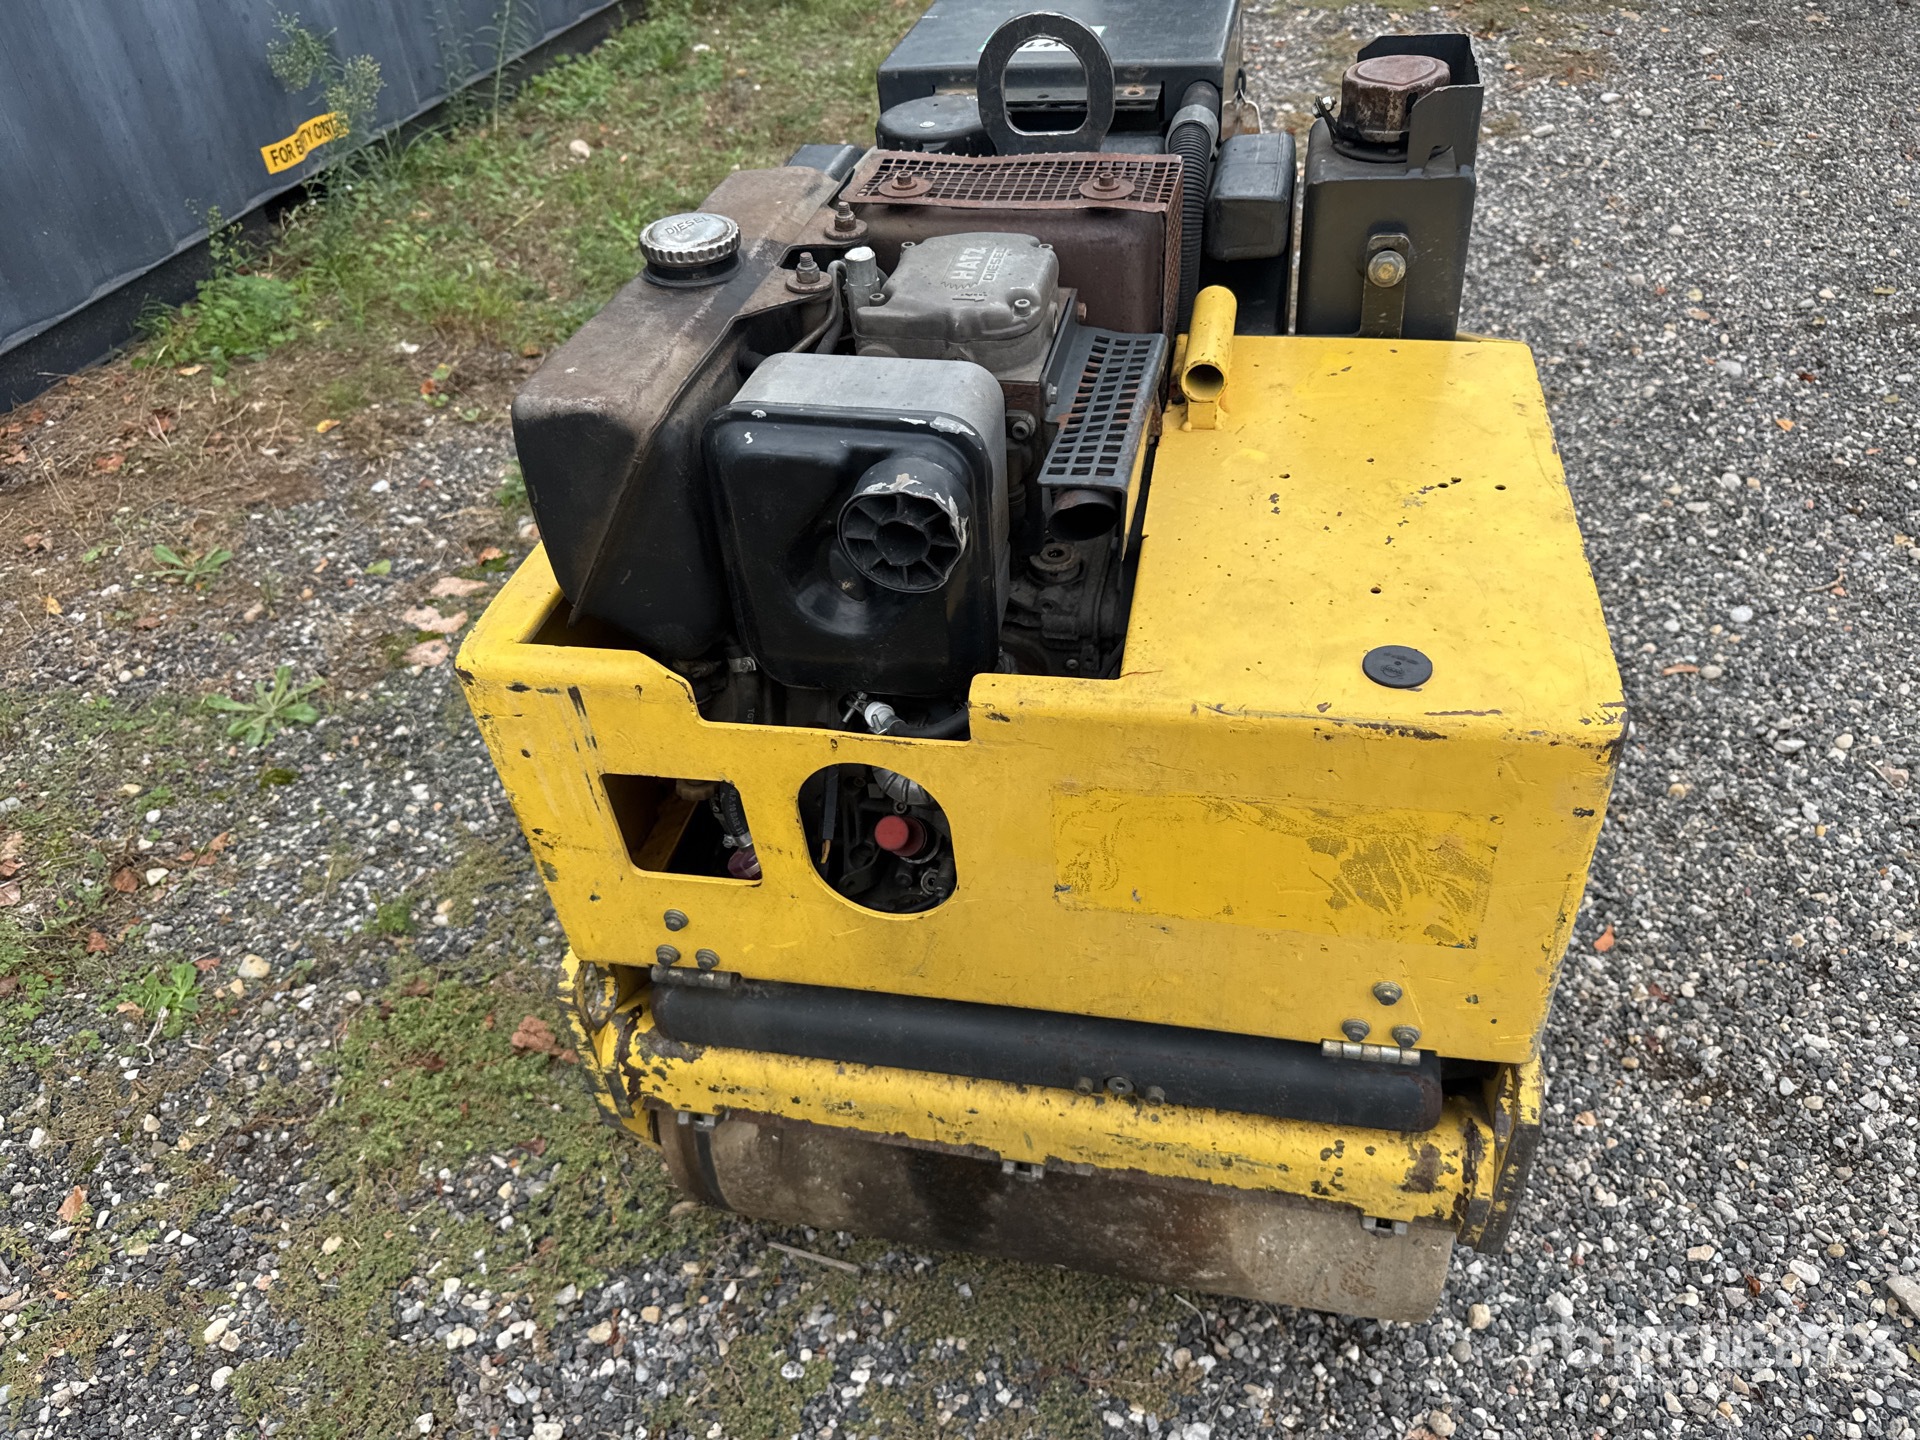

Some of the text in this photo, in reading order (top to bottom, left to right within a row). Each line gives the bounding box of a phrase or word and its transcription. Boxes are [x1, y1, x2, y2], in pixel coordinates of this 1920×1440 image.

[269, 143, 297, 168] FOR
[664, 216, 711, 235] DIESEL
[950, 246, 988, 280] HATZ
[981, 247, 1008, 281] DIESEL
